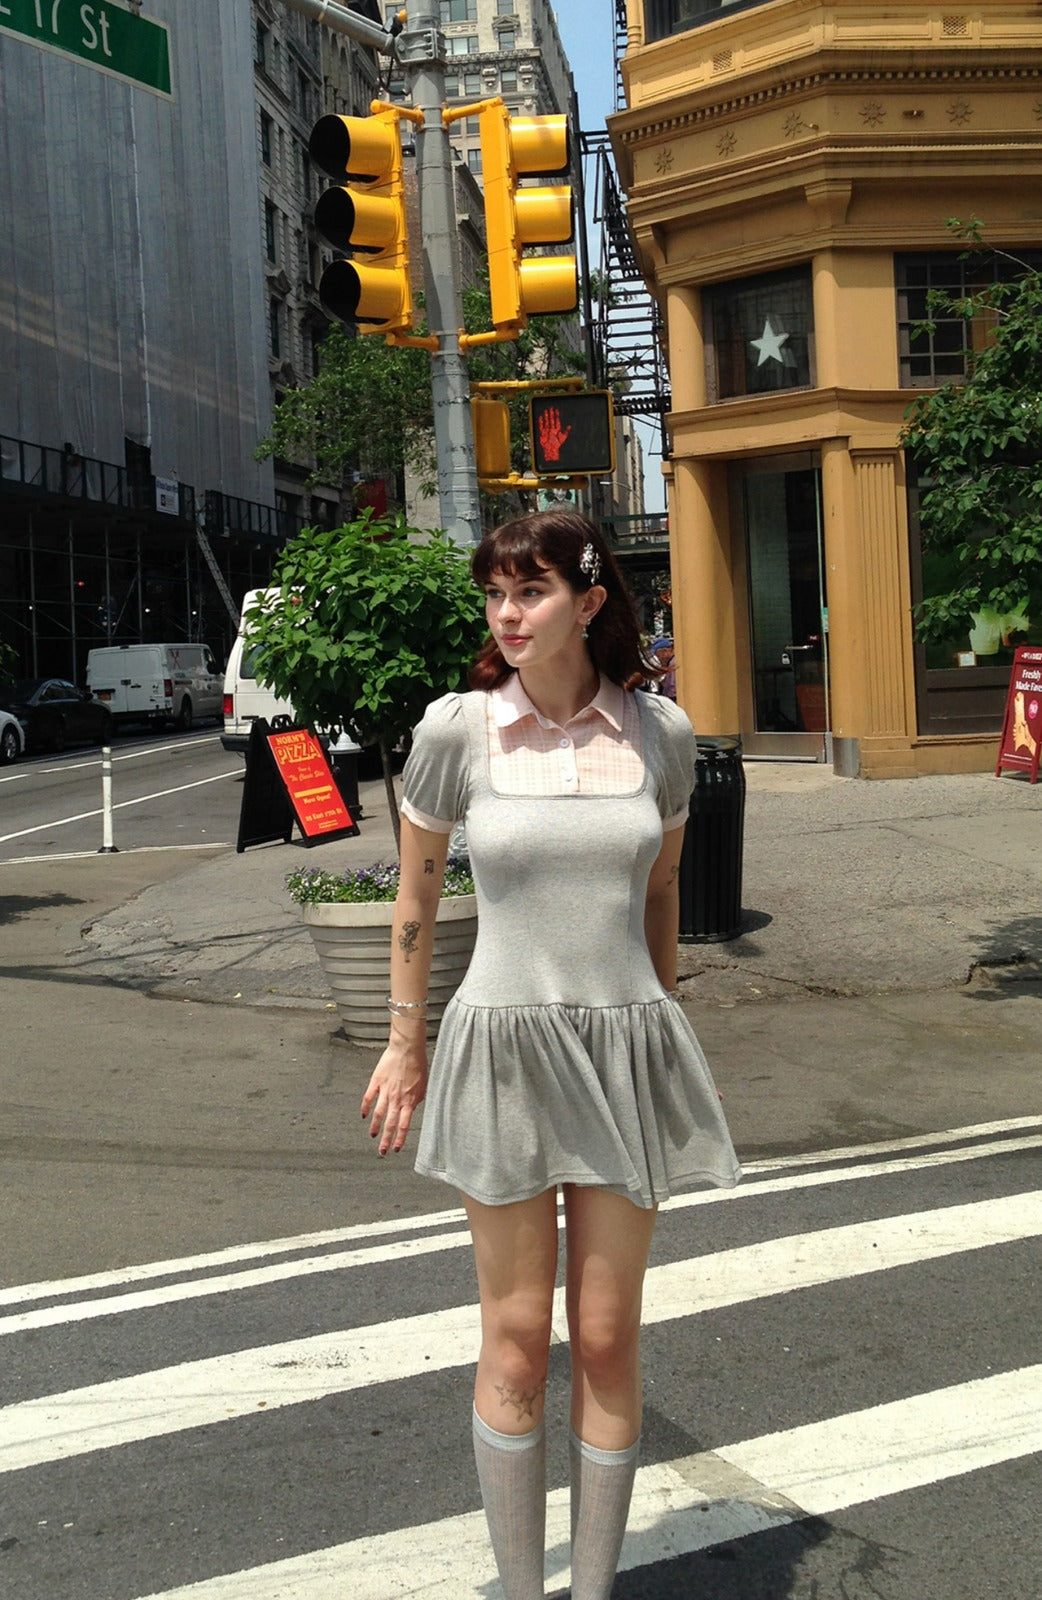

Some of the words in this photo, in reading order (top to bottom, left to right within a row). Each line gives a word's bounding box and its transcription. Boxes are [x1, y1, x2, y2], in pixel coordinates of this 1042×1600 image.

[80, 4, 112, 57] St
[1022, 669, 1041, 681] Freshly
[1015, 680, 1030, 691] Made
[275, 740, 321, 765] PIZZA
